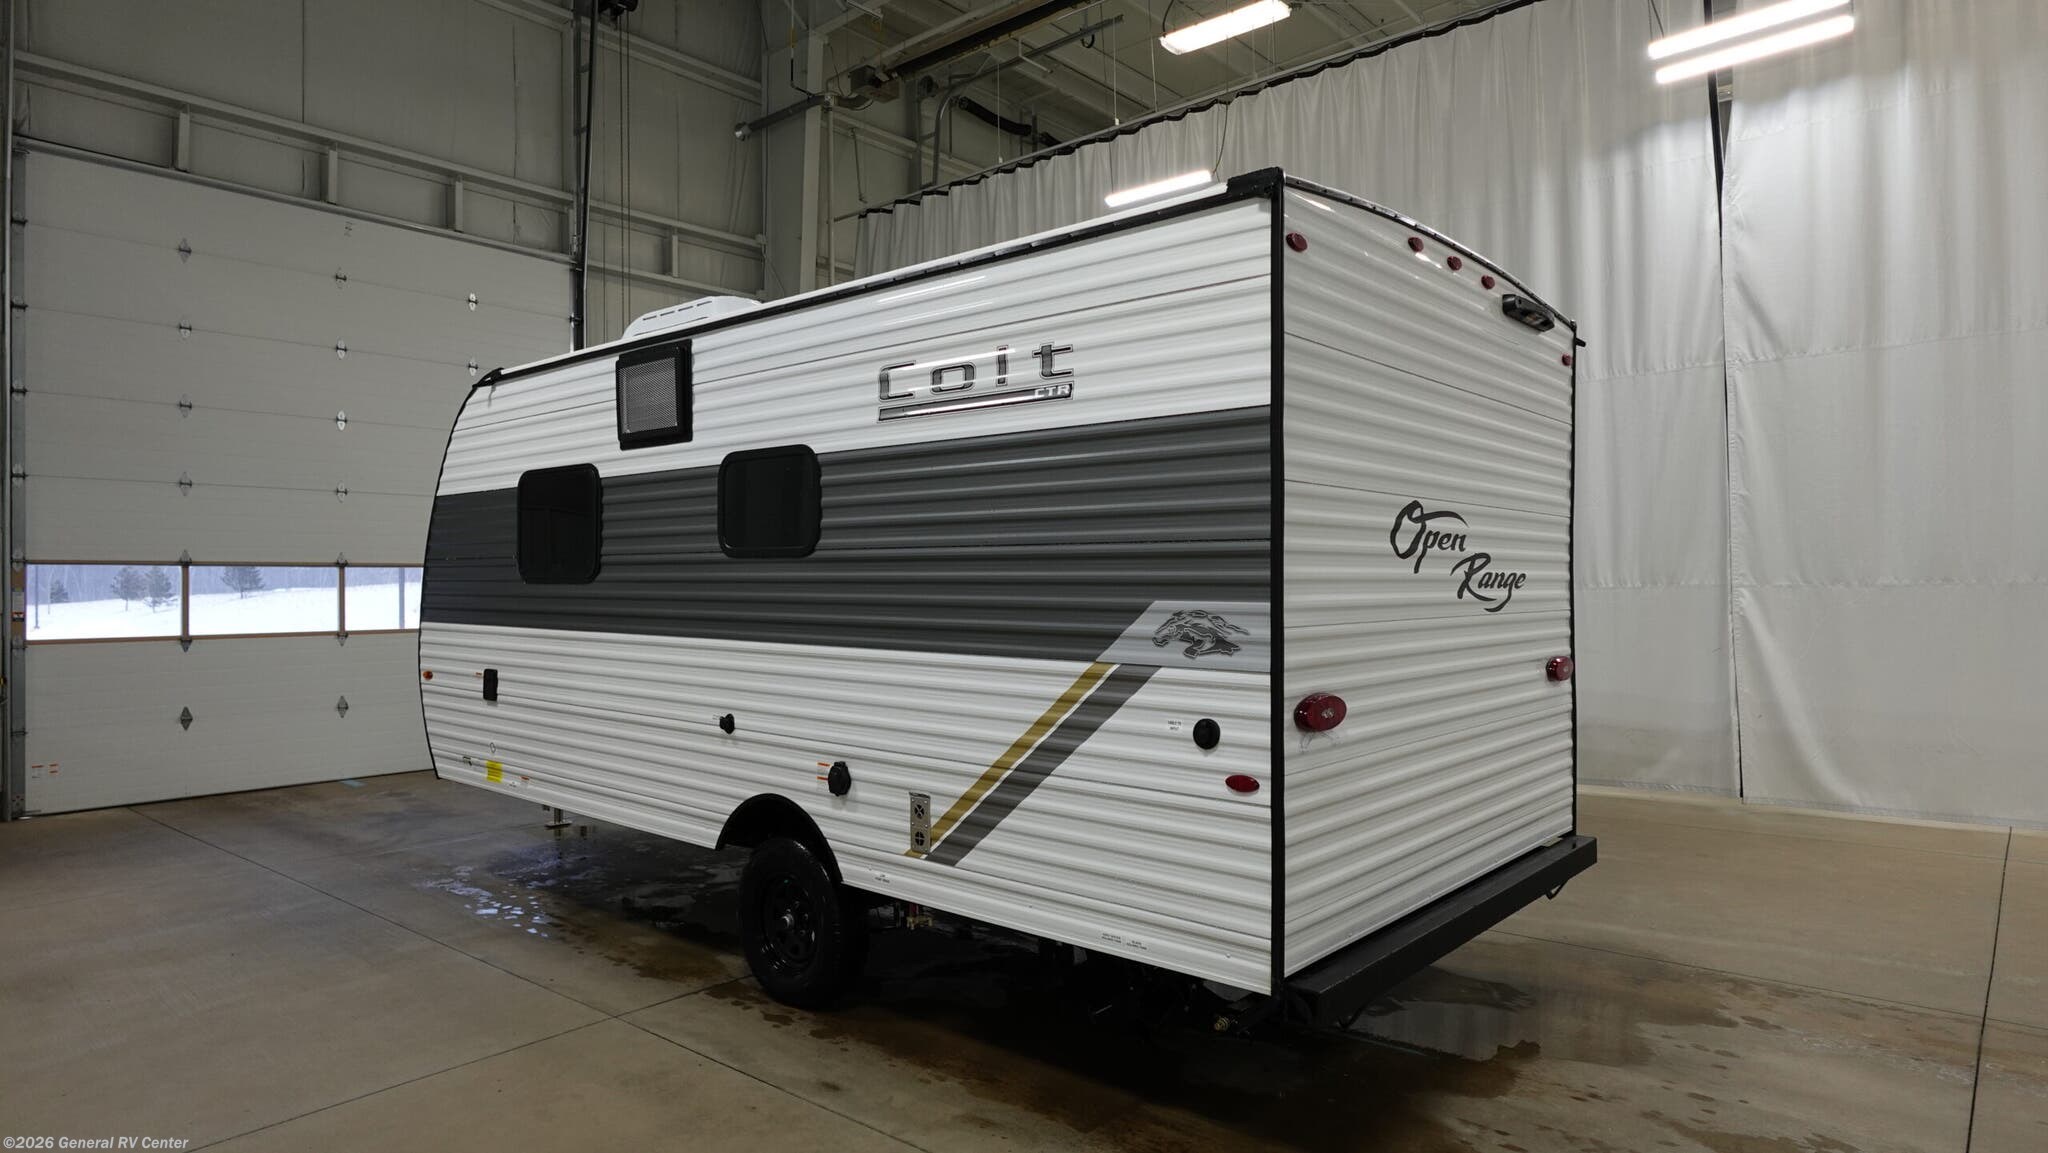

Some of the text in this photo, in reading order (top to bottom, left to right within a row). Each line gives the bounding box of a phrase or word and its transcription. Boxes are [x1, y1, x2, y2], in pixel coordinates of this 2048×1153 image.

[879, 342, 1073, 400] Colt
[1390, 500, 1469, 574] Open
[1450, 552, 1527, 612] Range
